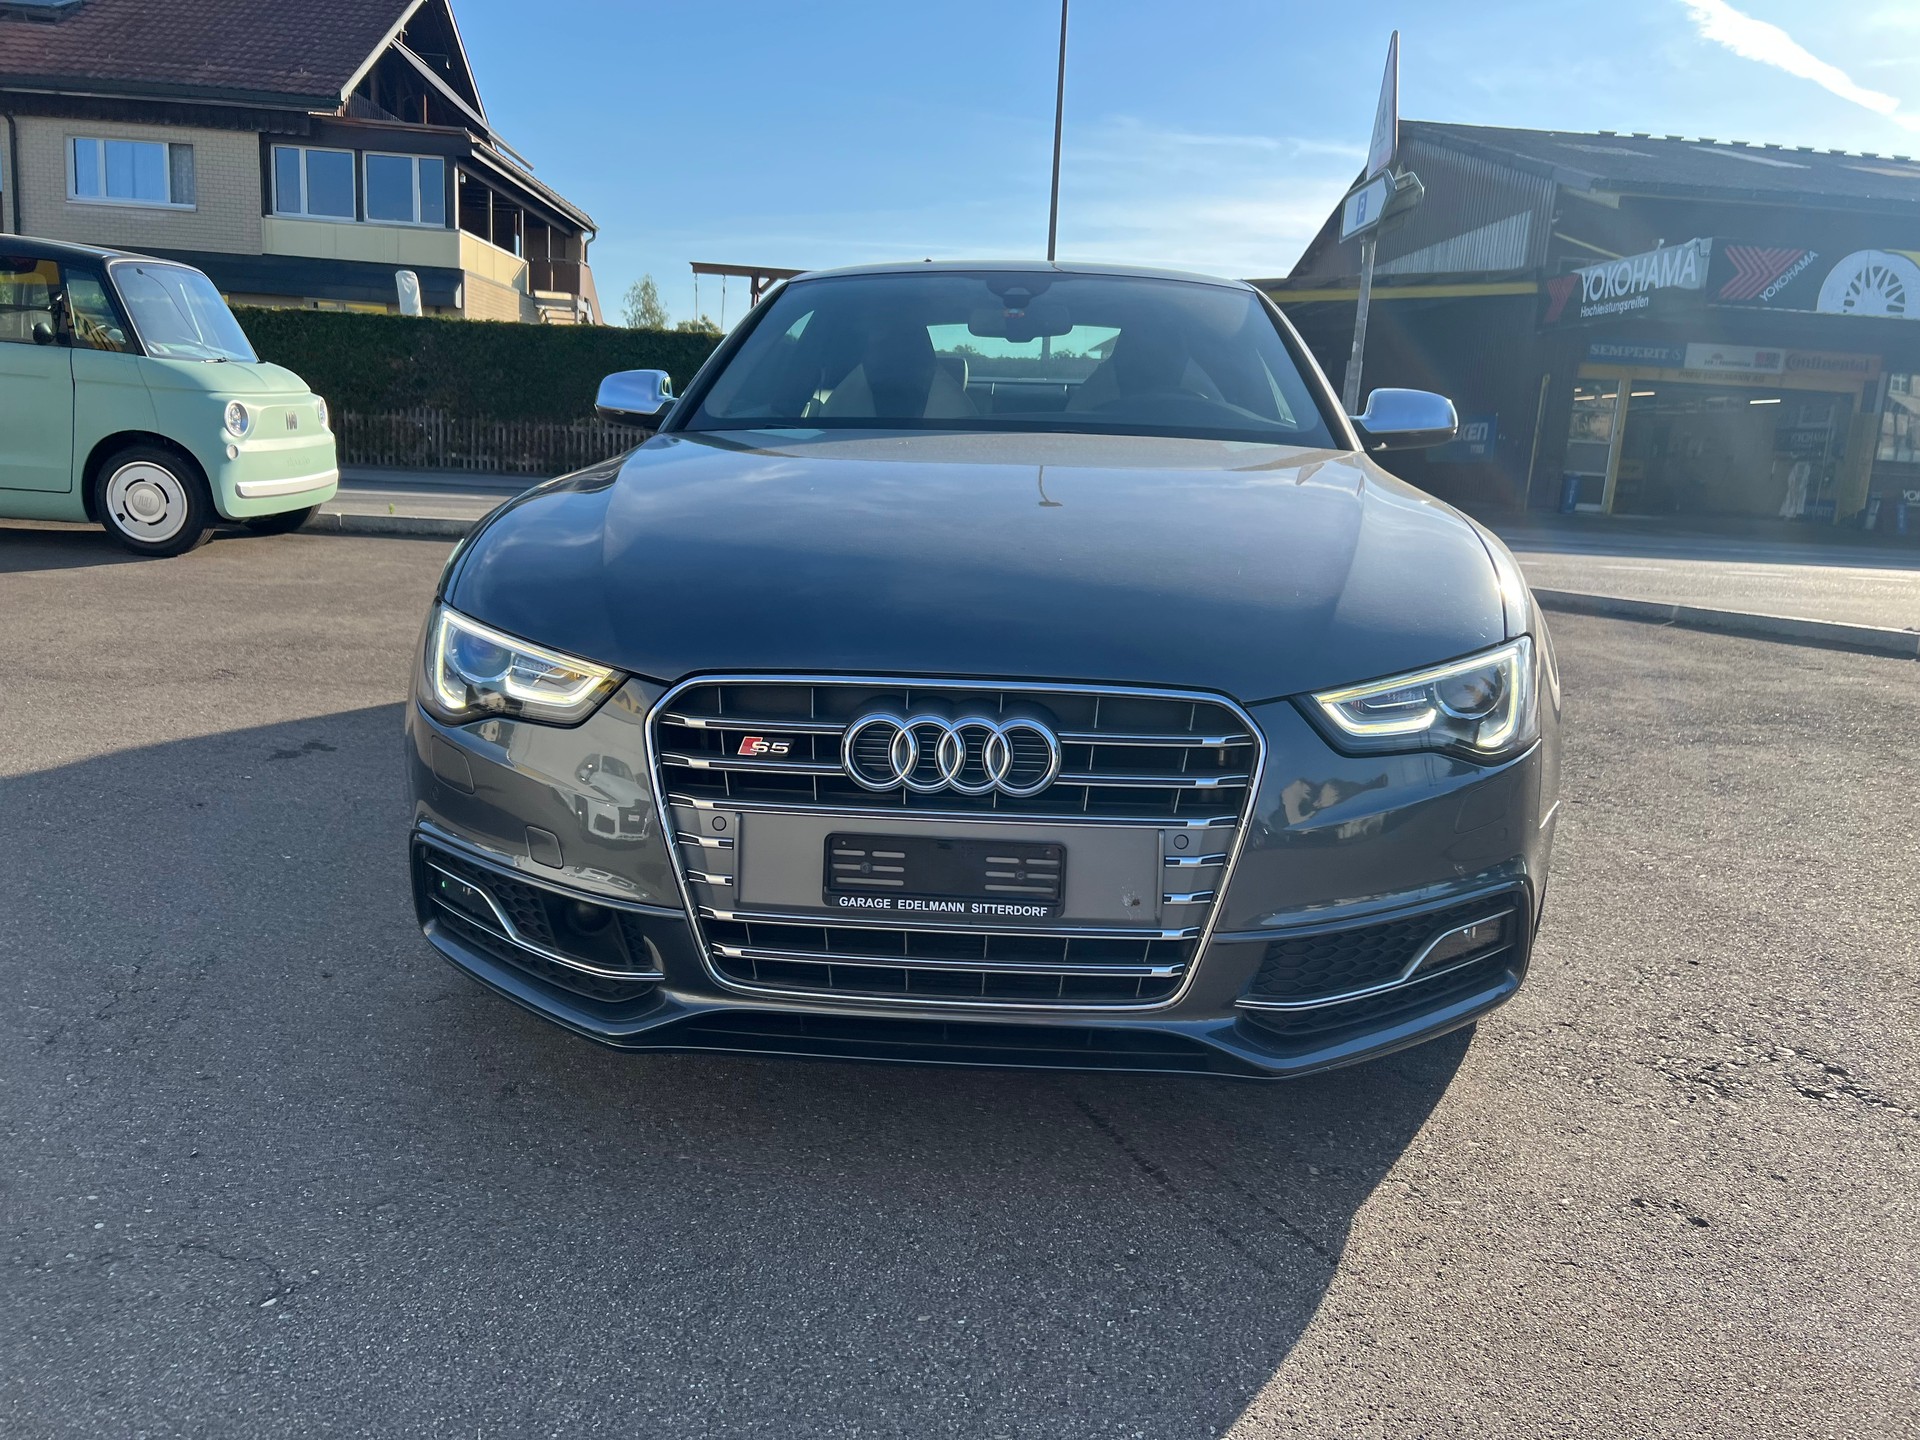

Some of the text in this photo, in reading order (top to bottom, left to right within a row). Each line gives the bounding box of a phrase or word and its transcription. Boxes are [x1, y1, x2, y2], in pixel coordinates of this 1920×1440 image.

[1581, 248, 1696, 303] YOKOHAMA
[1759, 250, 1818, 301] YOKOHAMA
[1580, 295, 1649, 317] Hochleistungsreifen
[1590, 344, 1669, 360] SEMPERIT
[1785, 354, 1869, 373] Continental
[746, 740, 790, 754] S5
[839, 896, 1048, 917] GARAGE EDELMANN SITTERDORF
